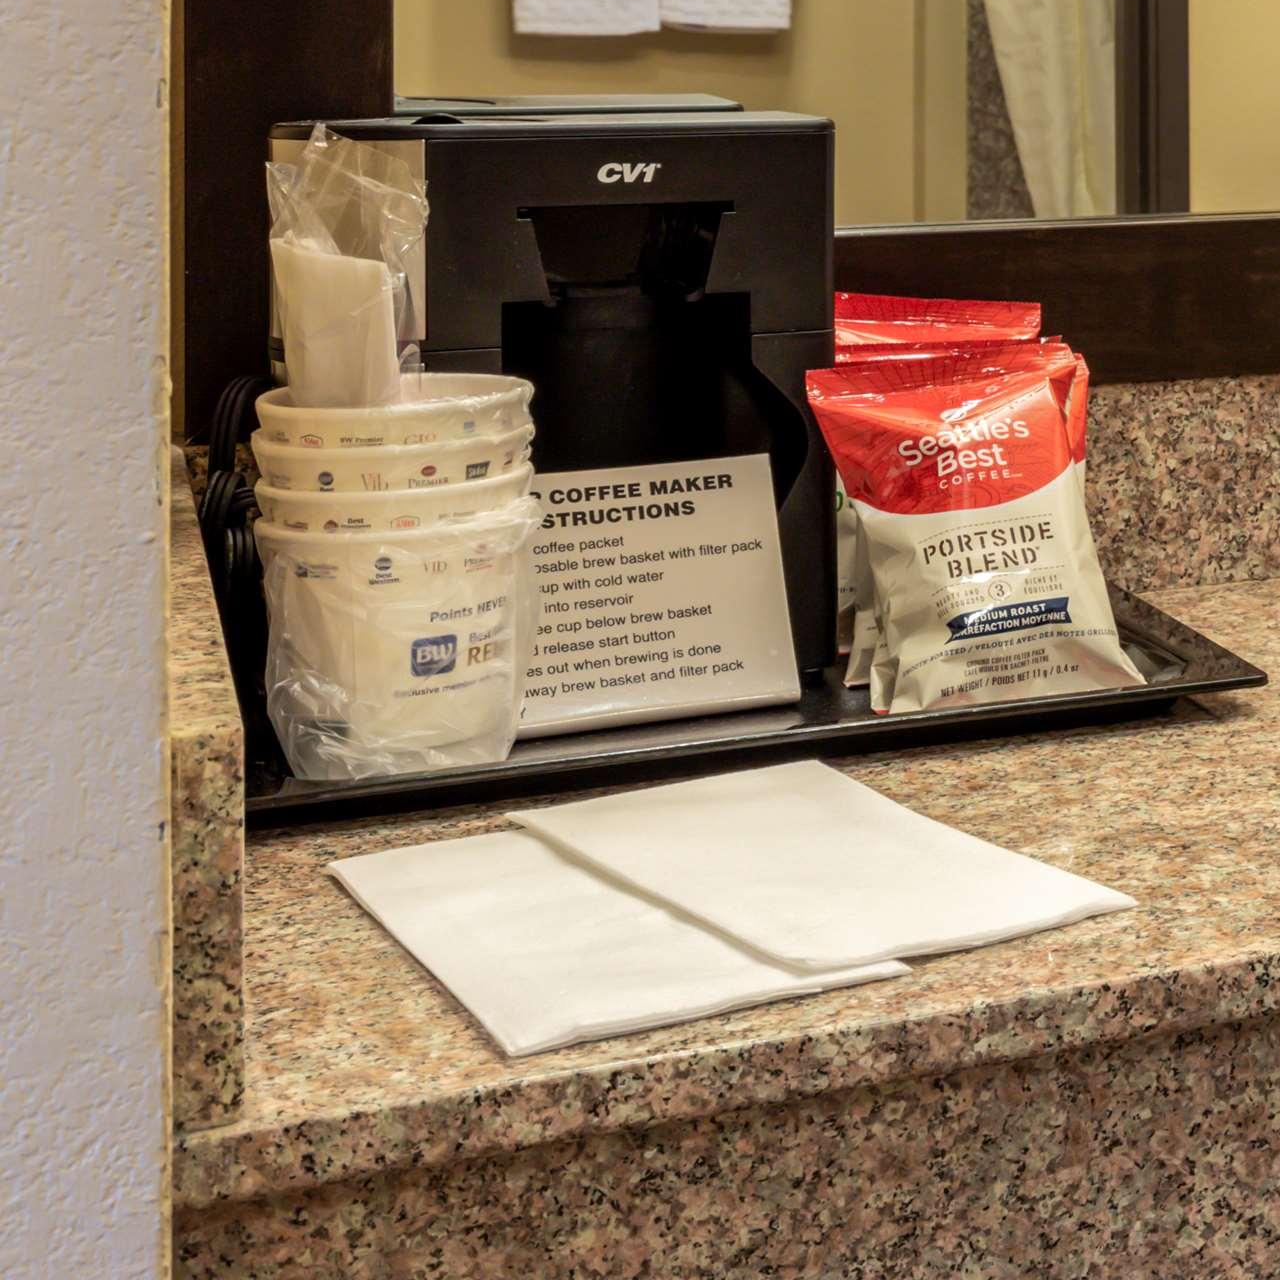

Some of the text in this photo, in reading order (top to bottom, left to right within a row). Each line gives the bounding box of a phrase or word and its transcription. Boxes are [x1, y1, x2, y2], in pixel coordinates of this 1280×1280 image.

[898, 418, 1030, 490] Seattle's Best COFFEE
[549, 483, 642, 505] COFFEE
[650, 474, 733, 496] MAKER
[537, 500, 696, 530] STRUCTIONS
[533, 536, 624, 556] coffee packet
[535, 539, 763, 574] osable brew basket with filter pack
[923, 521, 1054, 565] PORTSIDE
[947, 547, 1038, 579] BLEND
[563, 577, 590, 592] with
[594, 573, 622, 588] cold
[627, 571, 664, 584] water
[994, 583, 1006, 598] 3
[430, 607, 473, 622] Points
[544, 594, 634, 614] into reservoir
[964, 609, 1008, 625] MEDIUM
[1010, 603, 1047, 617] ROAST
[537, 604, 712, 636] ee cup below brew basket
[1021, 611, 1067, 627] MOYENNE
[543, 639, 595, 655] release
[598, 635, 628, 648] start
[633, 630, 676, 644] button
[1016, 634, 1037, 644] AVEC
[1039, 631, 1054, 639] DES
[1056, 630, 1085, 638] NOTES
[415, 642, 456, 664] BW
[547, 663, 569, 675] out
[573, 658, 611, 672] when
[615, 650, 669, 667] brewing
[672, 647, 684, 658] is
[688, 643, 722, 656] done
[561, 679, 596, 694] brew
[600, 673, 645, 689] basket
[650, 669, 675, 682] and
[679, 664, 708, 677] filter
[712, 659, 744, 675] pack
[940, 686, 955, 697] NET
[957, 679, 984, 693] WEIGHT
[992, 674, 1016, 686] POIDS
[1017, 670, 1030, 682] NET
[1032, 669, 1041, 678] 11
[1056, 664, 1068, 674] 0.4
